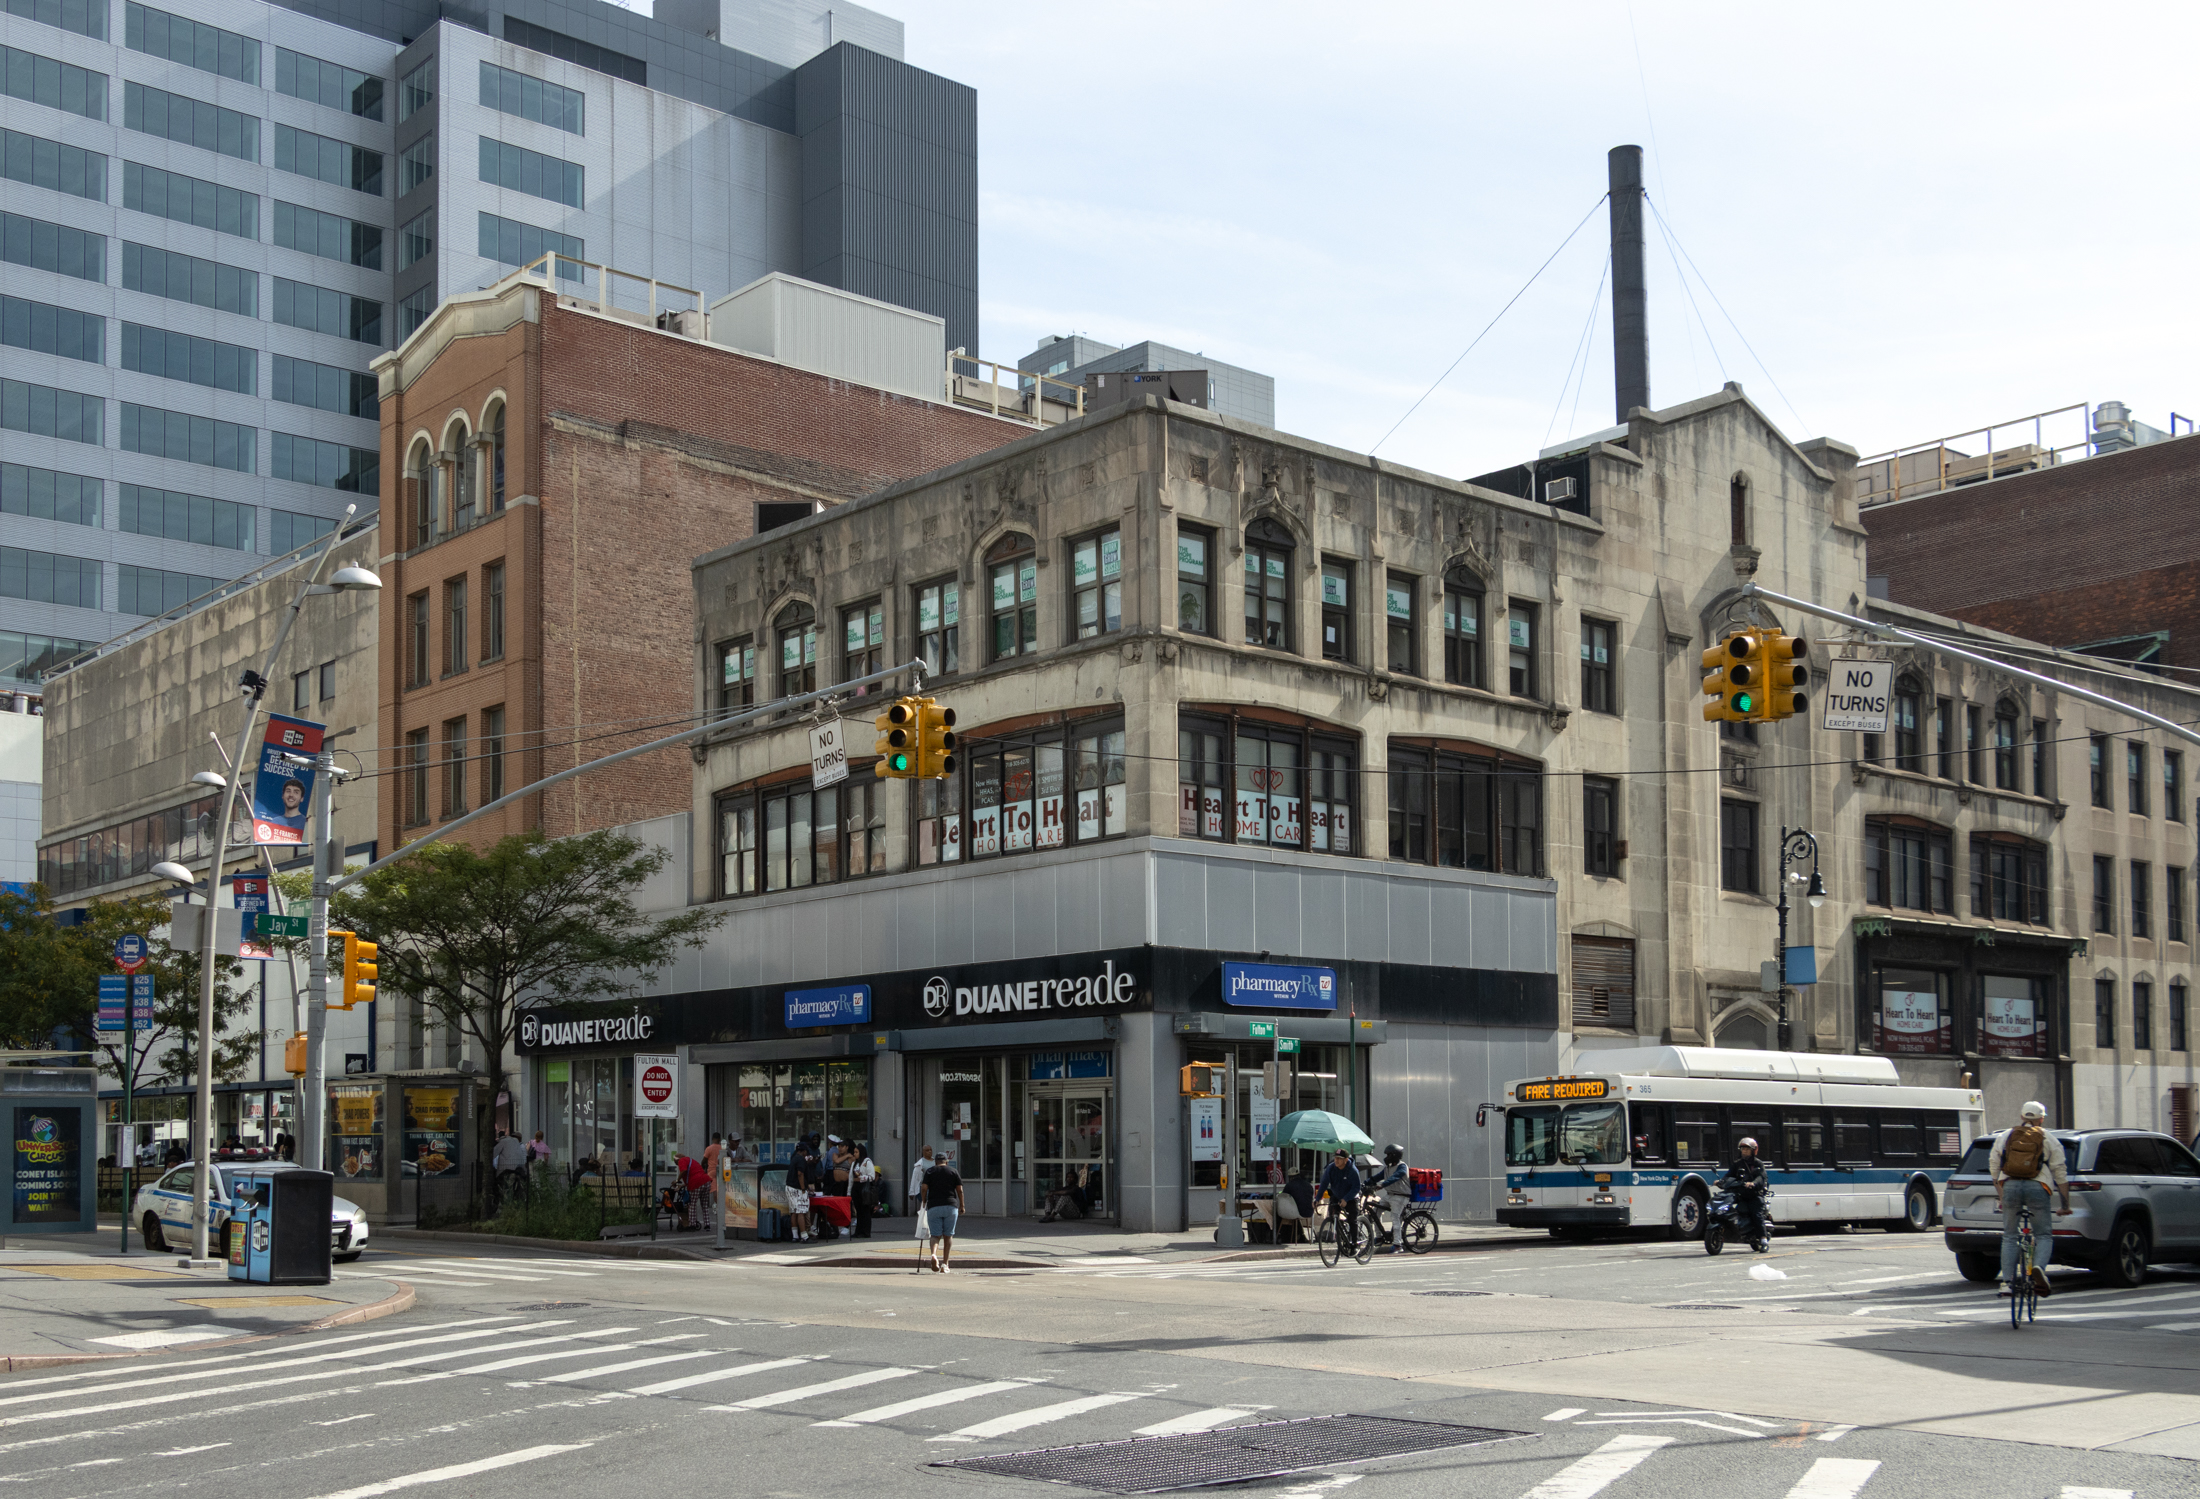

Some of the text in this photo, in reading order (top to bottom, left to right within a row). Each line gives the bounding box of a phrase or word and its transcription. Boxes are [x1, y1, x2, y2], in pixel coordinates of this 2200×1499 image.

[1141, 375, 1162, 383] YORK
[1104, 551, 1118, 564] GROW
[1179, 552, 1192, 560] HOPE
[1179, 556, 1203, 566] PROGRAM
[1076, 567, 1097, 576] PROGRAM
[1388, 605, 1410, 615] ROGRAM
[1846, 670, 1873, 688] NO
[1830, 695, 1885, 713] TURNS
[819, 731, 834, 749] NO
[814, 748, 844, 771] TURNS
[264, 763, 296, 778] SUCCESS.
[817, 774, 831, 786] EXCEPT
[1184, 789, 1345, 830] Heart To Heart
[932, 814, 996, 847] Heart
[1004, 805, 1031, 833] To
[1209, 817, 1261, 837] HOME
[1275, 825, 1316, 844] CARE
[977, 828, 1063, 853] HOME CARE
[268, 918, 299, 937] Jay St
[135, 976, 149, 984] B25
[1231, 971, 1301, 999] pharmacy
[1301, 975, 1319, 997] Rx
[134, 987, 149, 995] B26
[134, 998, 149, 1006] B38
[924, 985, 949, 1009] DR
[134, 1009, 149, 1017] B38
[789, 998, 840, 1021] pharmacy
[1885, 1008, 1935, 1021] Heart To Heart
[134, 1020, 148, 1028] B52
[1897, 1021, 1924, 1029] HOME CARE
[1988, 1013, 2032, 1026] Heart To Heart
[1252, 1024, 1266, 1035] Fulton
[2011, 1026, 2022, 1034] CARE
[1280, 1040, 1294, 1051] Smith
[638, 1057, 660, 1065] FULTON
[1526, 1082, 1604, 1100] FARE REQUIRED
[1639, 1085, 1652, 1094] 365
[343, 1108, 370, 1119] CHAD POWERS
[429, 1106, 450, 1114] POWERS
[29, 1152, 66, 1162] CIRCUS
[16, 1182, 51, 1190] COMING
[28, 1193, 49, 1201] JOIN
[728, 1199, 748, 1210] JESUS
